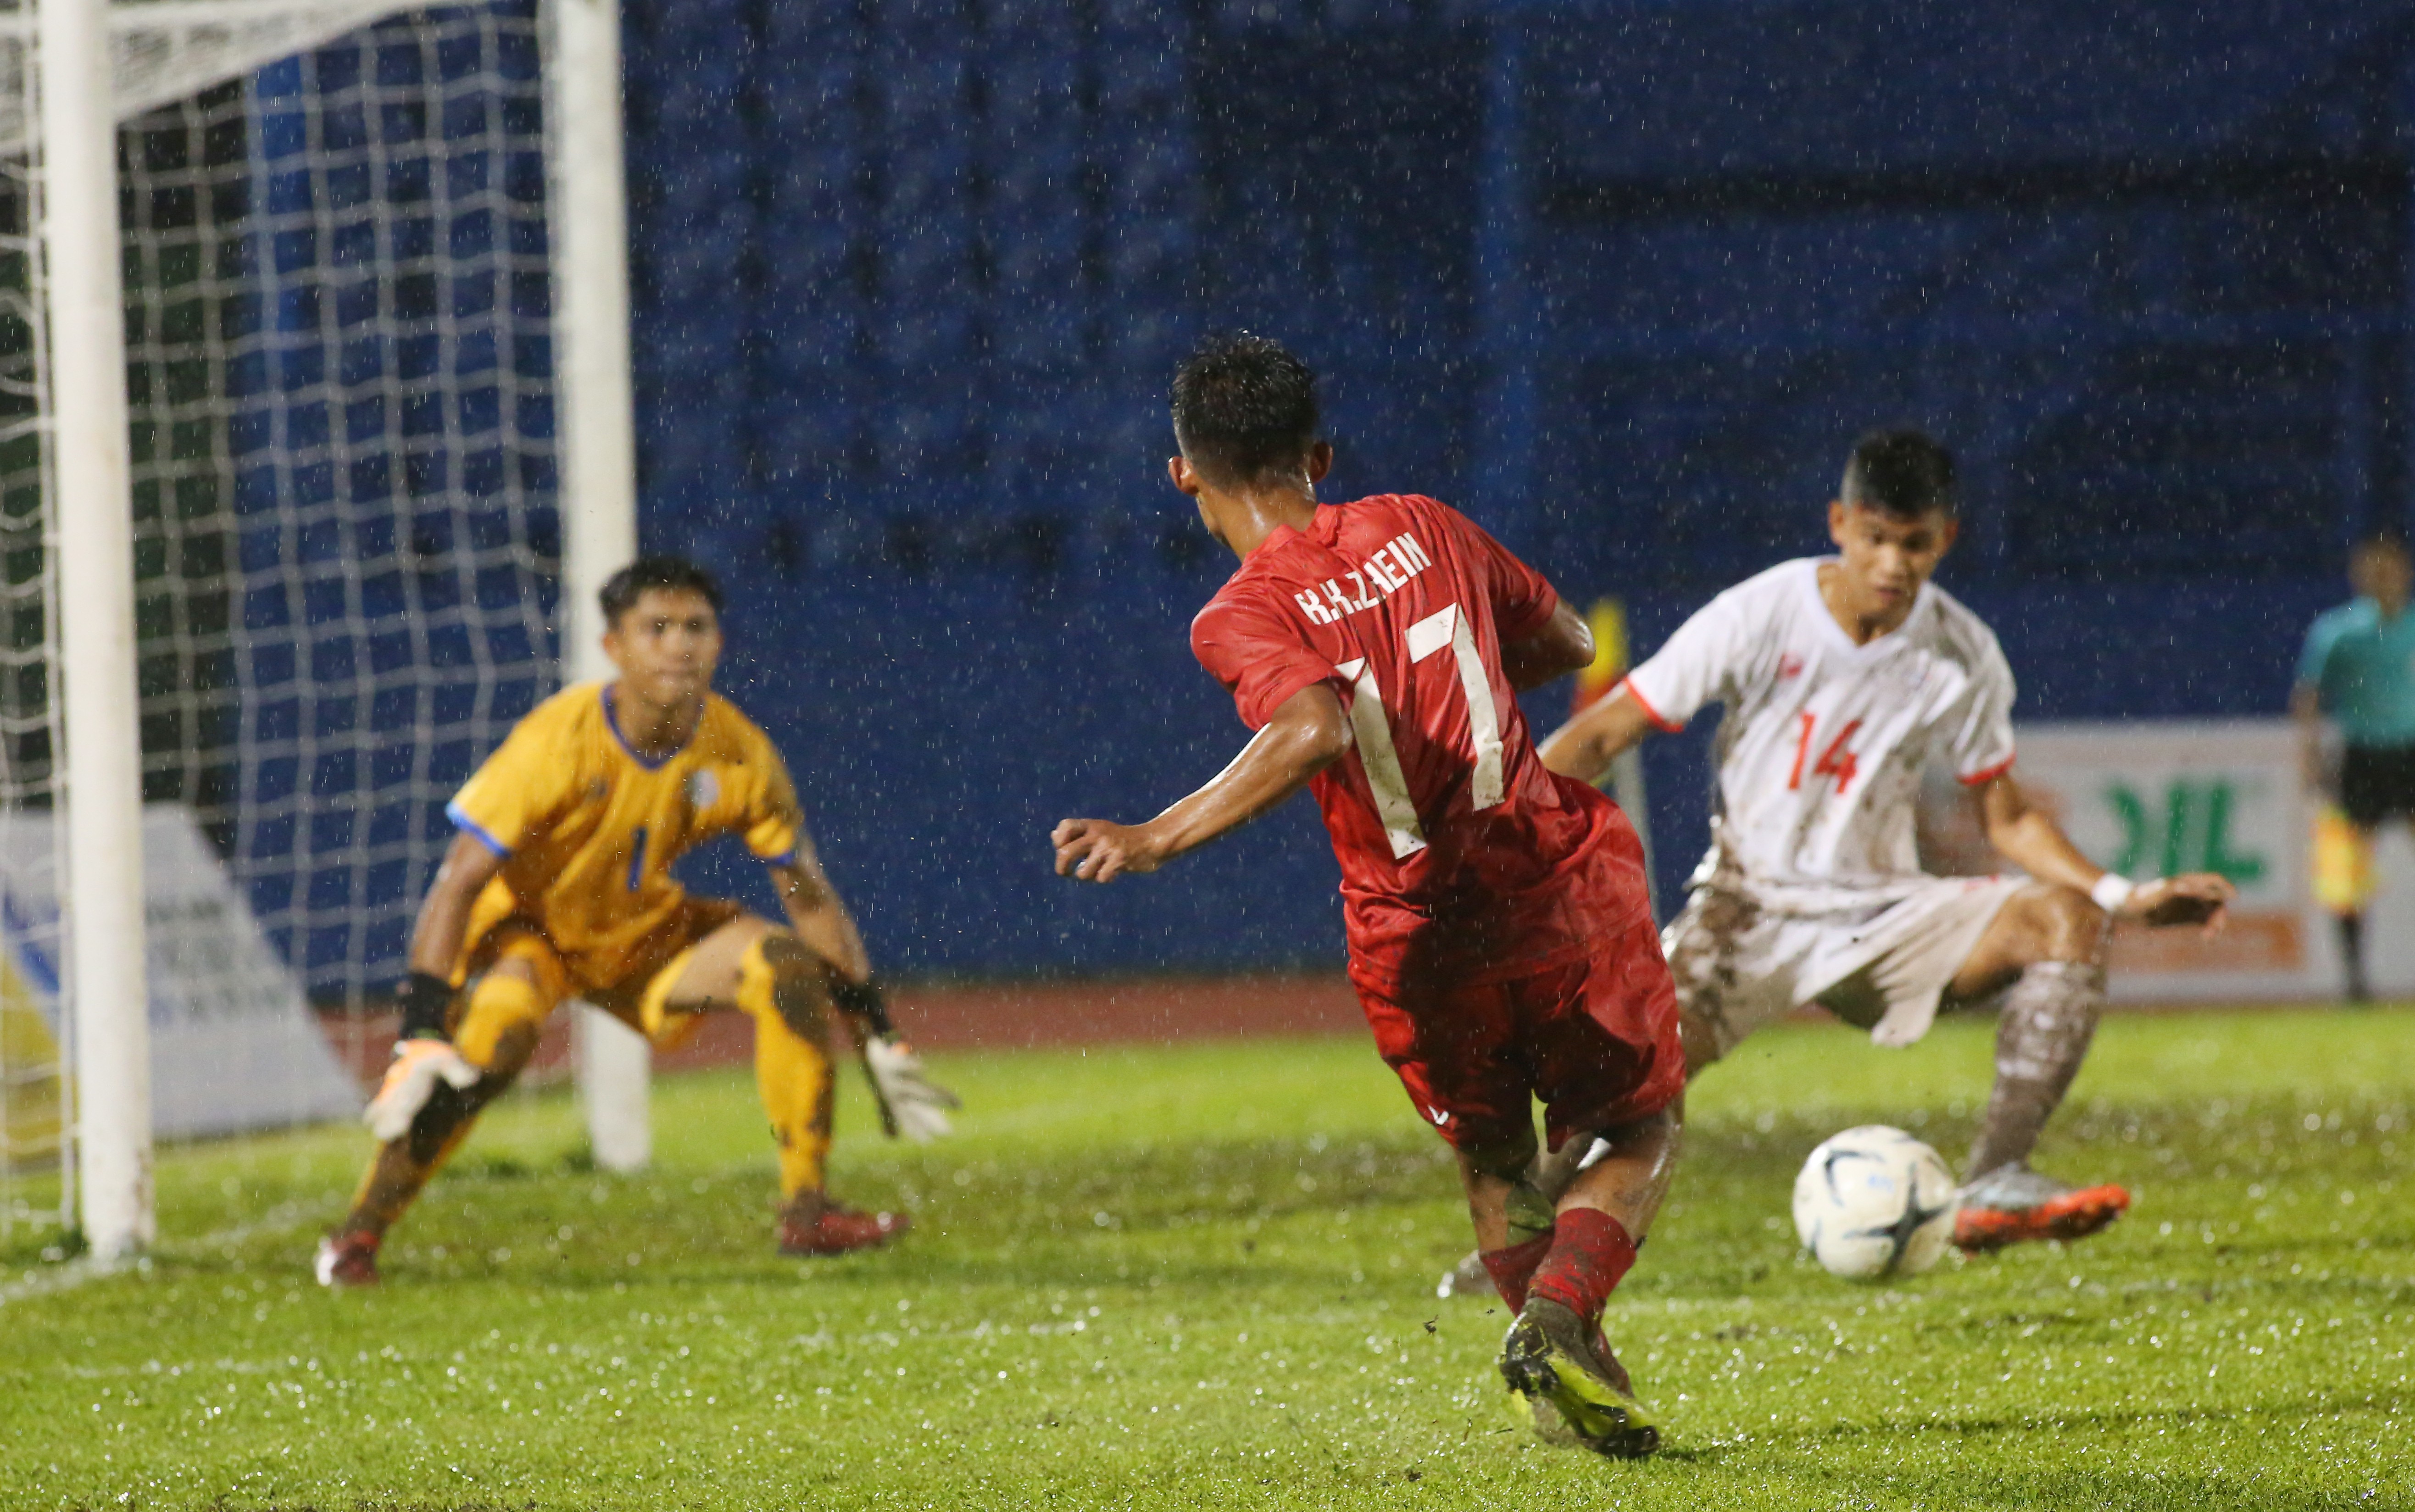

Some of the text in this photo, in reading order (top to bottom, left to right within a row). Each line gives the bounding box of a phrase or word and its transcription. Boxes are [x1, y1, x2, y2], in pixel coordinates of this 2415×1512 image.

[1335, 602, 1505, 859] 17
[1788, 711, 1863, 795] 14
[627, 826, 649, 892] 1
